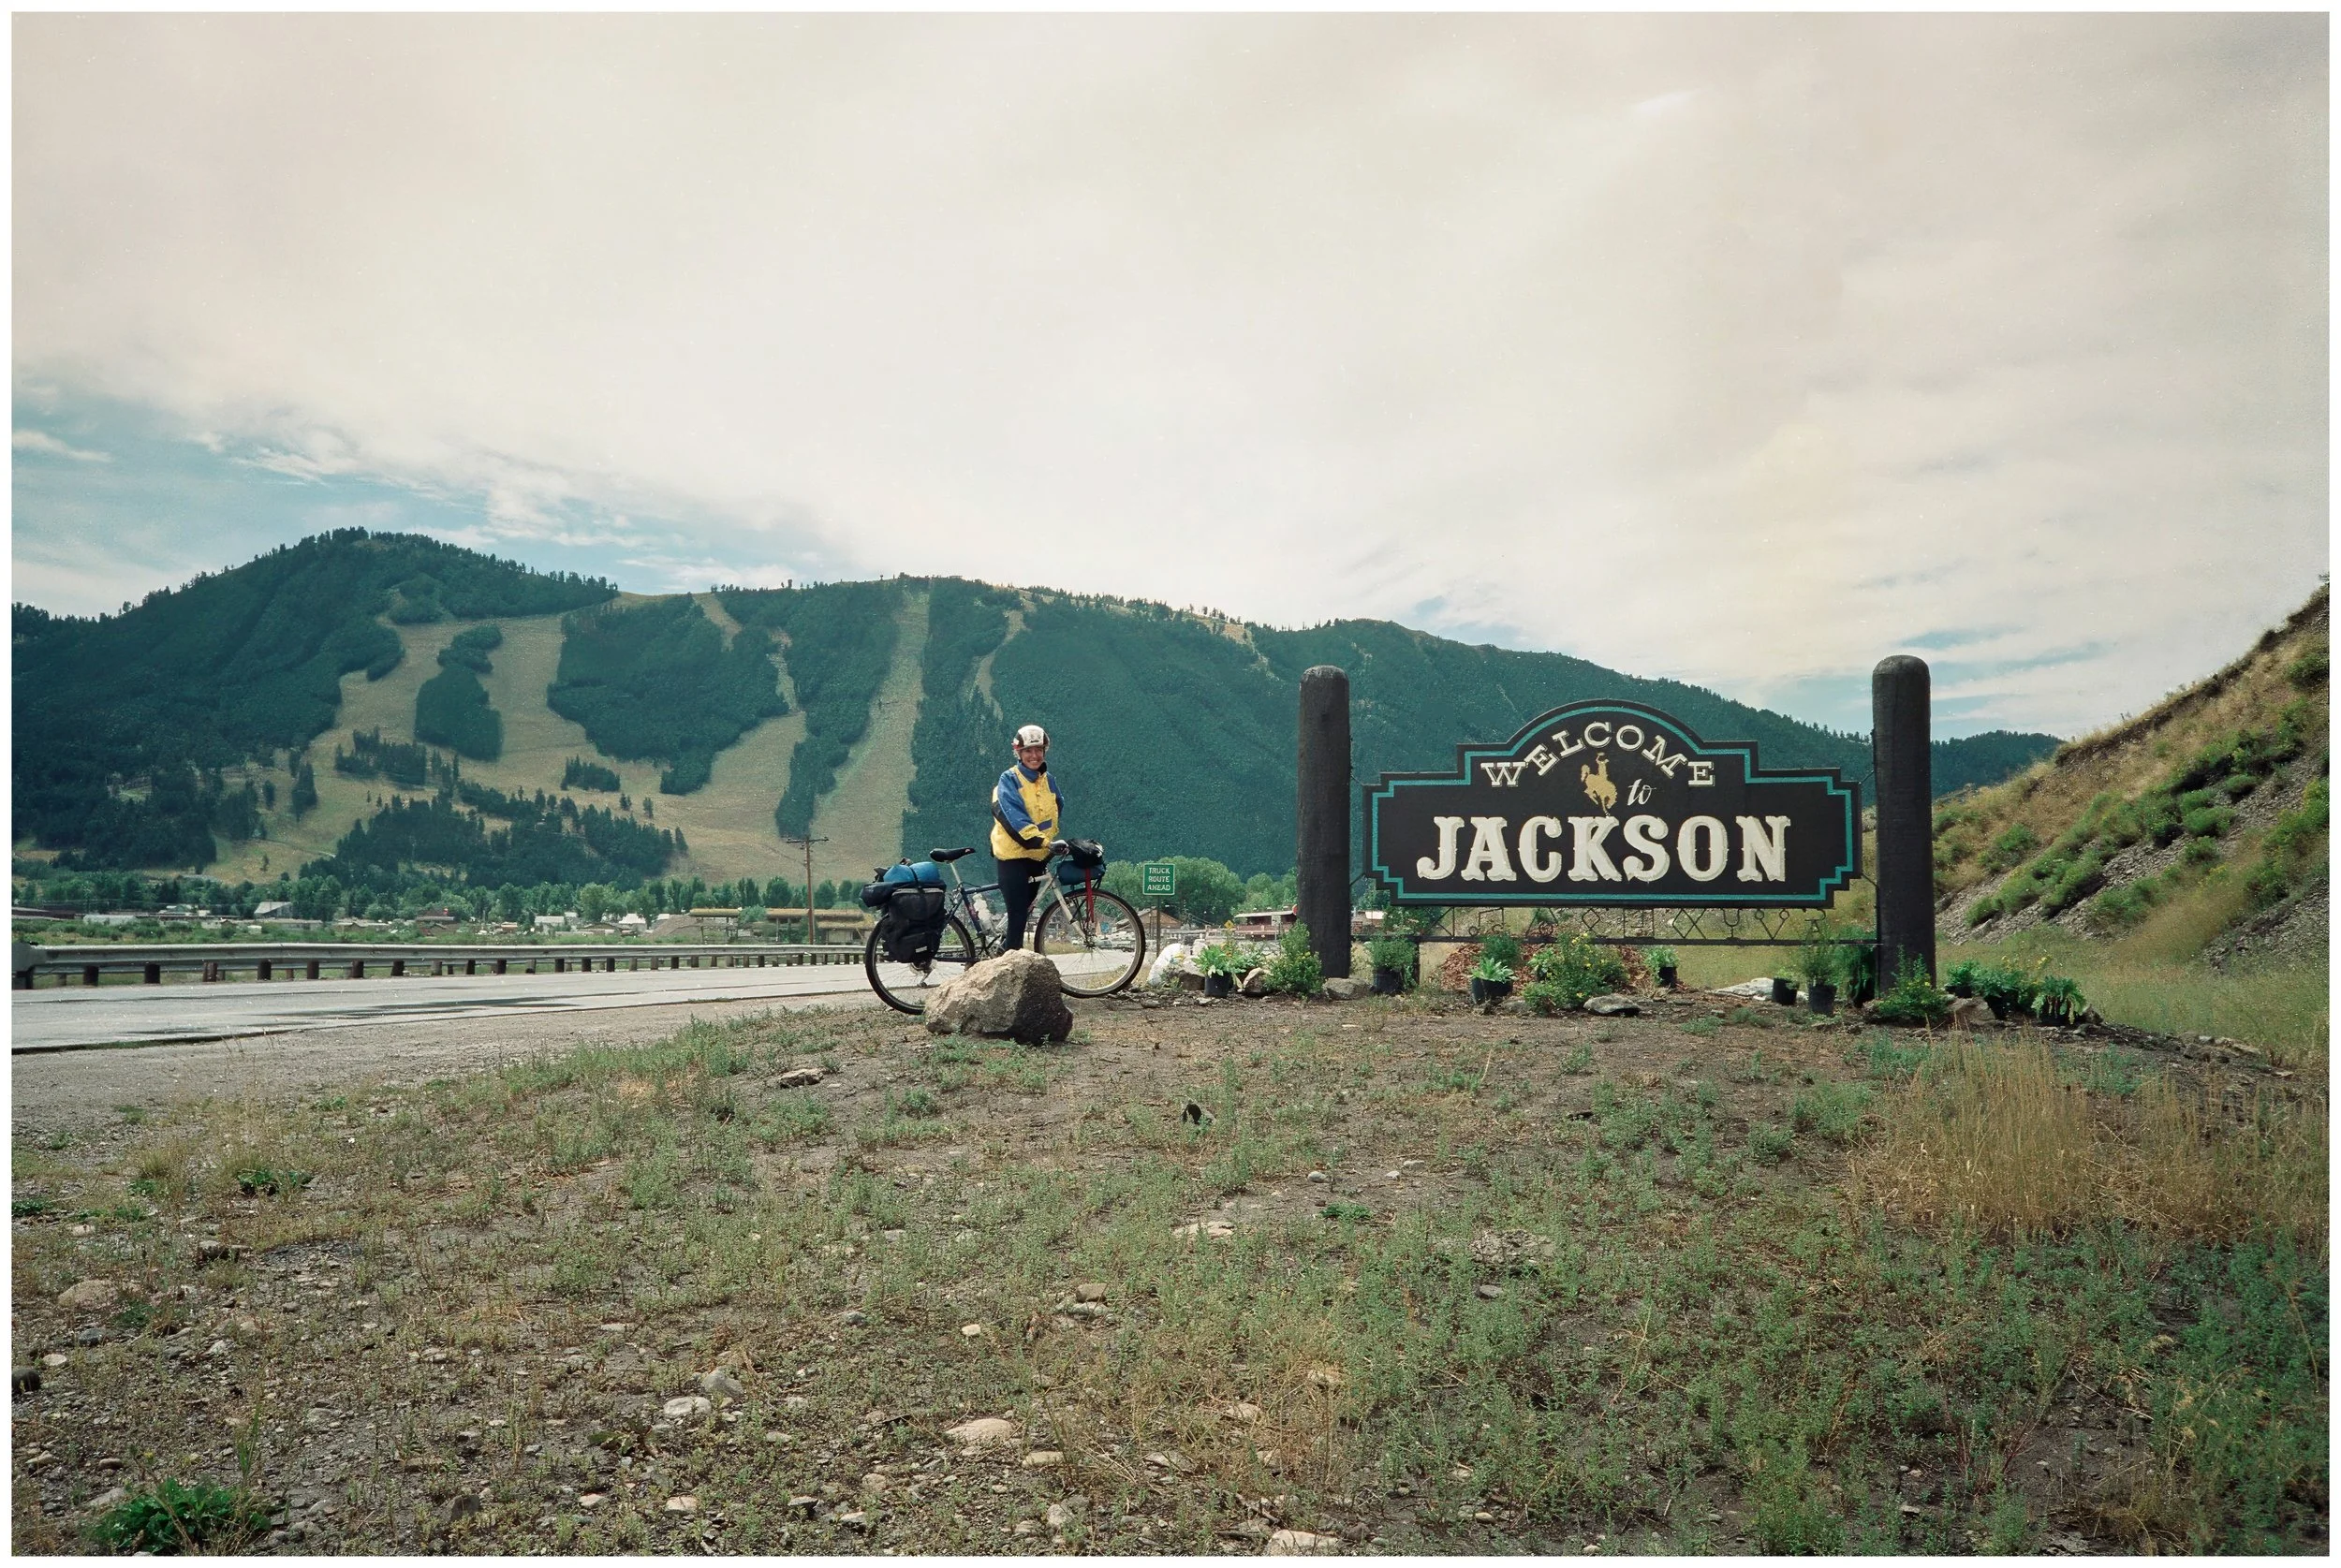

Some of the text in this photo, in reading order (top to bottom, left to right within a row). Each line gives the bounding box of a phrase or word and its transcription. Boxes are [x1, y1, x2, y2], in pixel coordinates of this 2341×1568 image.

[1480, 722, 1715, 786] WELCOME
[1627, 778, 1656, 806] to
[1416, 815, 1790, 883] JACKSON
